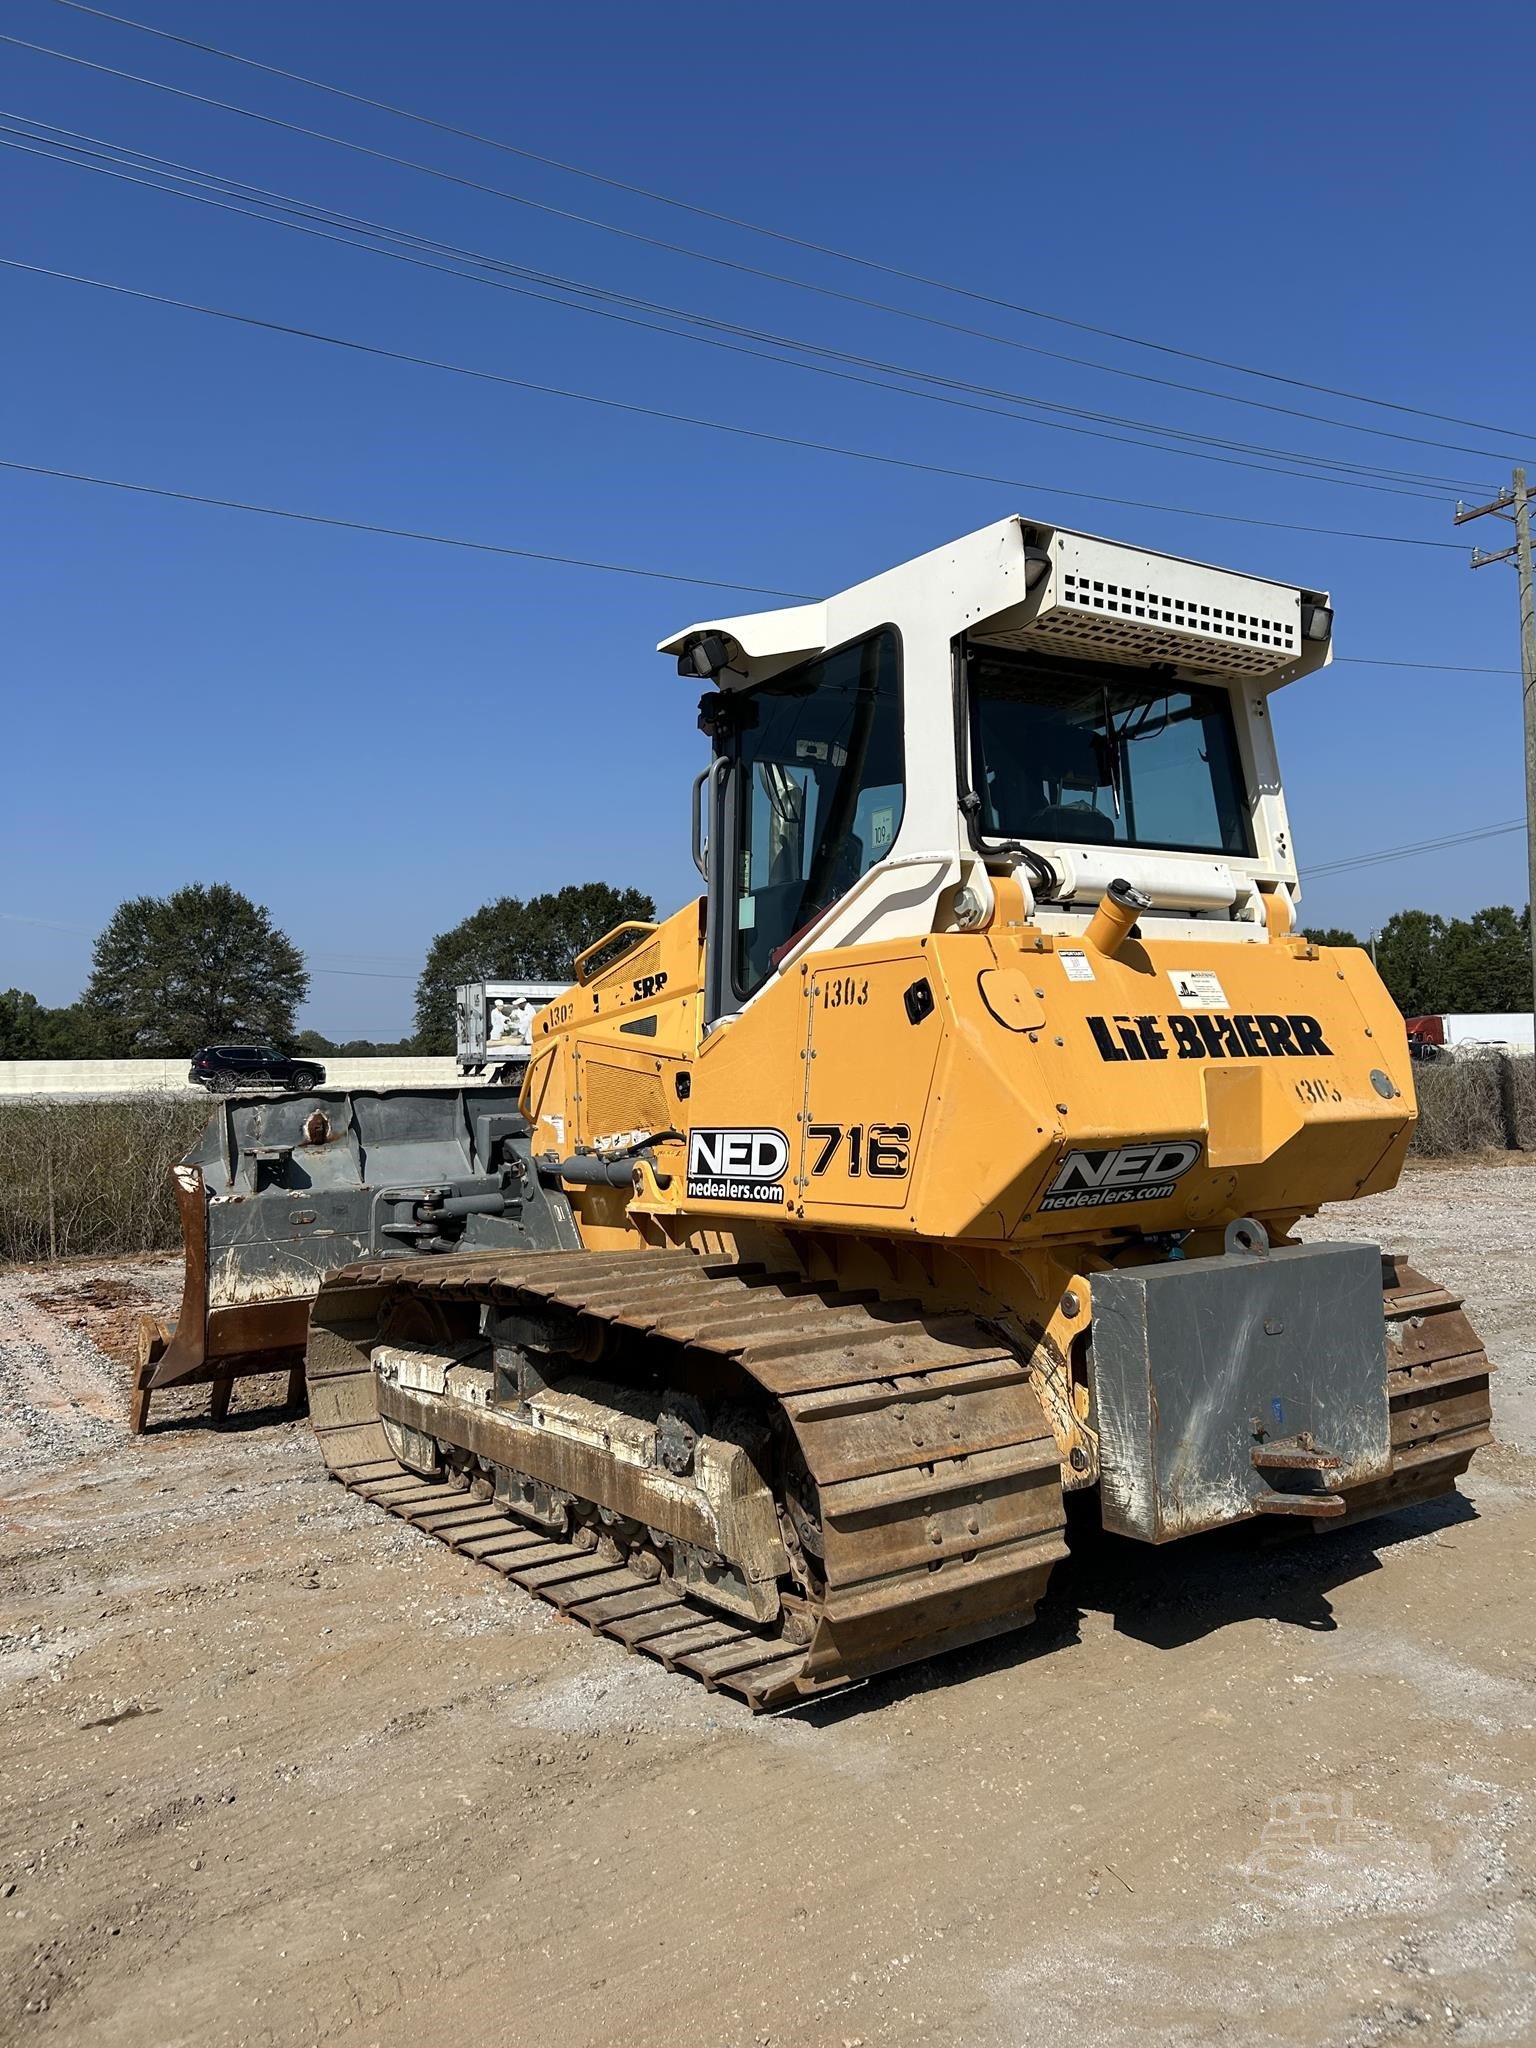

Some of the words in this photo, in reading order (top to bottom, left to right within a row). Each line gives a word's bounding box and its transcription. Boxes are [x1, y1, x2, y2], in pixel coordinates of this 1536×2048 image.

[824, 977, 869, 1009] 1303
[1085, 1014, 1335, 1062] LIEBHERR
[691, 1133, 787, 1176] NED
[807, 1123, 911, 1179] 716
[1052, 1144, 1197, 1190] NED
[688, 1179, 783, 1201] nedealers.com
[1040, 1184, 1175, 1210] nedealers.com
